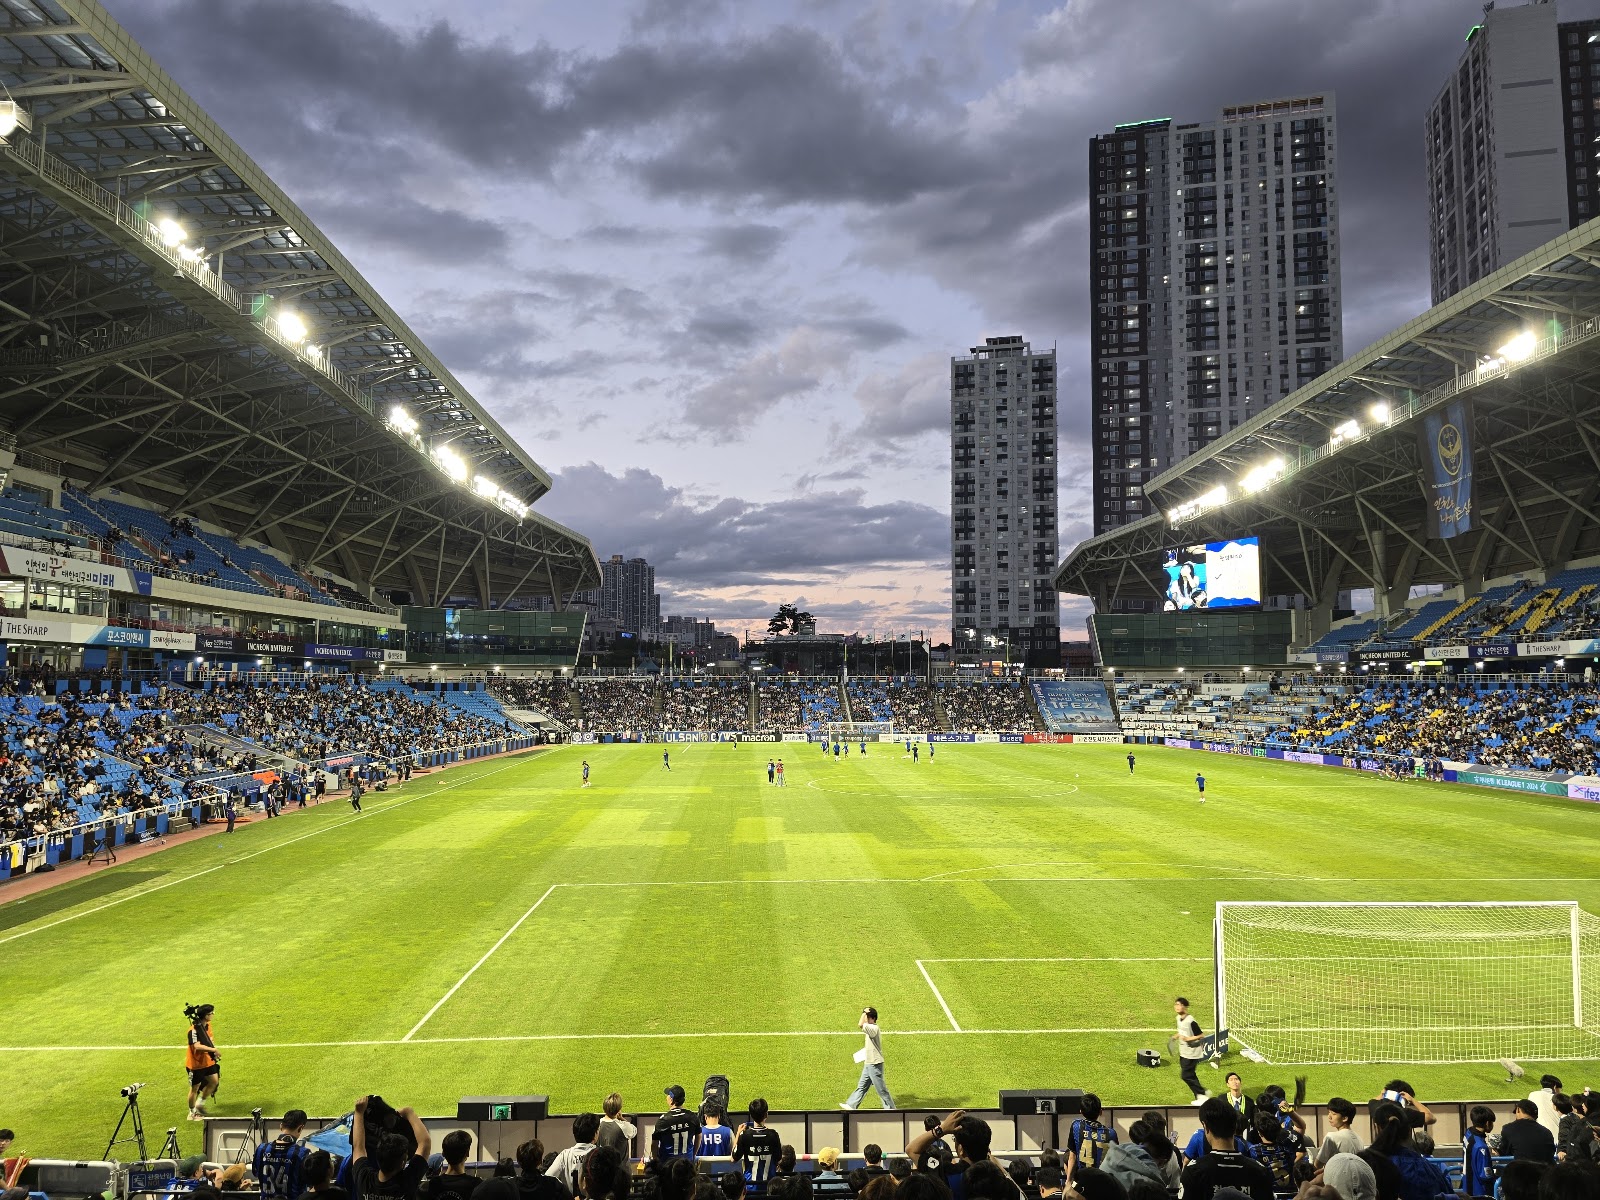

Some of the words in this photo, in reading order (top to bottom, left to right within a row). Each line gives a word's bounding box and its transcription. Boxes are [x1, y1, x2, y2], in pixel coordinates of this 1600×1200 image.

[26, 559, 48, 574] 인천의
[49, 557, 63, 577] 꿈
[61, 570, 92, 584] 대한민국의
[92, 572, 115, 587] 미래
[7, 622, 22, 634] THE
[22, 623, 49, 636] SHARP
[107, 630, 144, 644] 포스코이앤씨
[247, 642, 270, 652] INCHEON
[270, 644, 287, 652] UNITED
[1438, 649, 1461, 657] 신한은행
[1484, 647, 1510, 655] 신한은행
[1382, 651, 1401, 659] UNITED
[666, 731, 699, 742] ULSAN
[741, 733, 776, 742] macron
[1501, 779, 1521, 788] LEAGUE
[1526, 782, 1539, 790] 2024
[1584, 786, 1600, 801] ifez
[672, 1131, 689, 1156] 11
[703, 1133, 722, 1145] HB
[747, 1154, 773, 1181] 77
